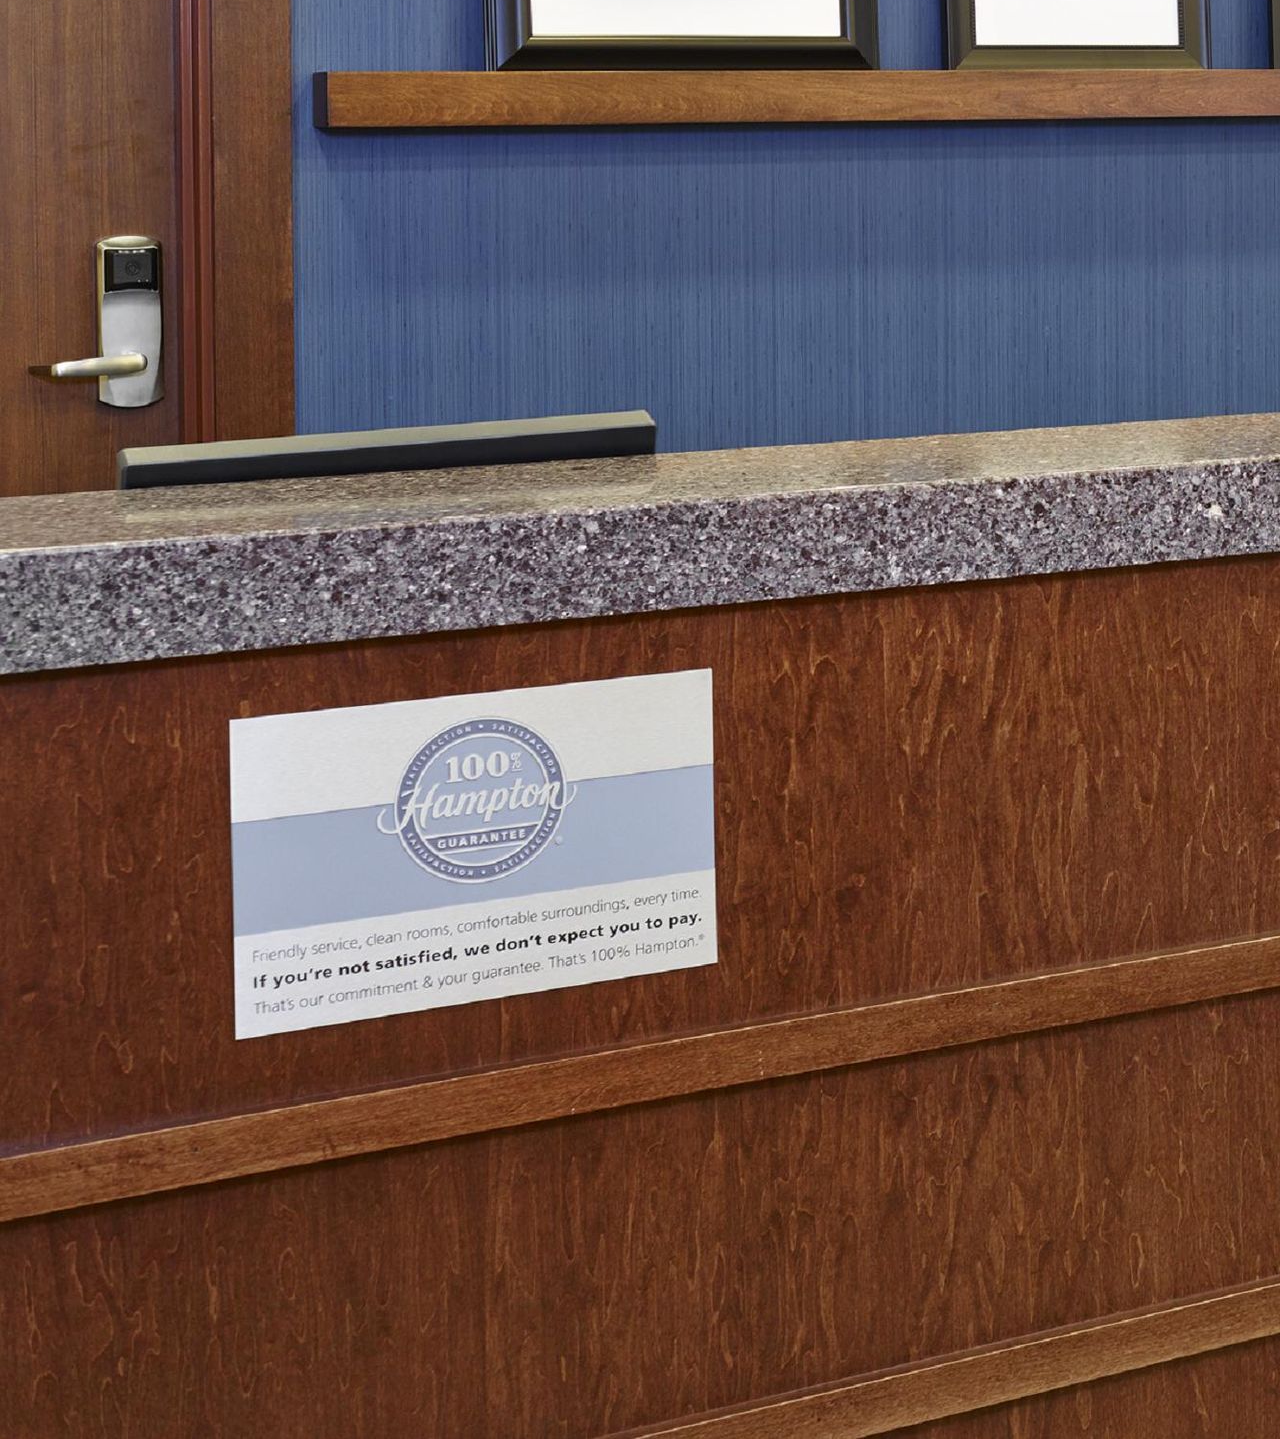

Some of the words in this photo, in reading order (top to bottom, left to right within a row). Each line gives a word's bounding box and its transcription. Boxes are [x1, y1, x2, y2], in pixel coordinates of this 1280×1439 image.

[406, 725, 472, 786] SATISFACTION
[492, 723, 557, 775] SATISFACTION
[377, 778, 577, 834] Hampton
[407, 832, 474, 877] SATISFACTION
[437, 829, 526, 849] GUARANTEE
[494, 812, 557, 874] SATISFACTION
[252, 944, 307, 963] Friendly
[312, 937, 362, 955] service,
[366, 931, 402, 946] clean
[407, 925, 453, 940] rooms,
[457, 910, 537, 934] comfortable
[542, 899, 630, 921] surroundings,
[634, 892, 667, 908] every
[253, 974, 267, 989] If
[273, 967, 333, 989] you're
[338, 961, 370, 976] not
[375, 947, 458, 970] satisfied,
[464, 943, 490, 957] we
[495, 932, 542, 952] don't
[547, 926, 604, 945] expect
[609, 919, 640, 937] you
[646, 917, 663, 929] to
[668, 912, 702, 929] pay.
[254, 999, 295, 1014] That's
[300, 994, 323, 1008] our
[328, 978, 418, 1004] commitment
[422, 975, 434, 988] &
[438, 972, 468, 990] your
[472, 961, 544, 985] guarantee.
[549, 952, 586, 970] That's
[591, 942, 630, 961] 100%
